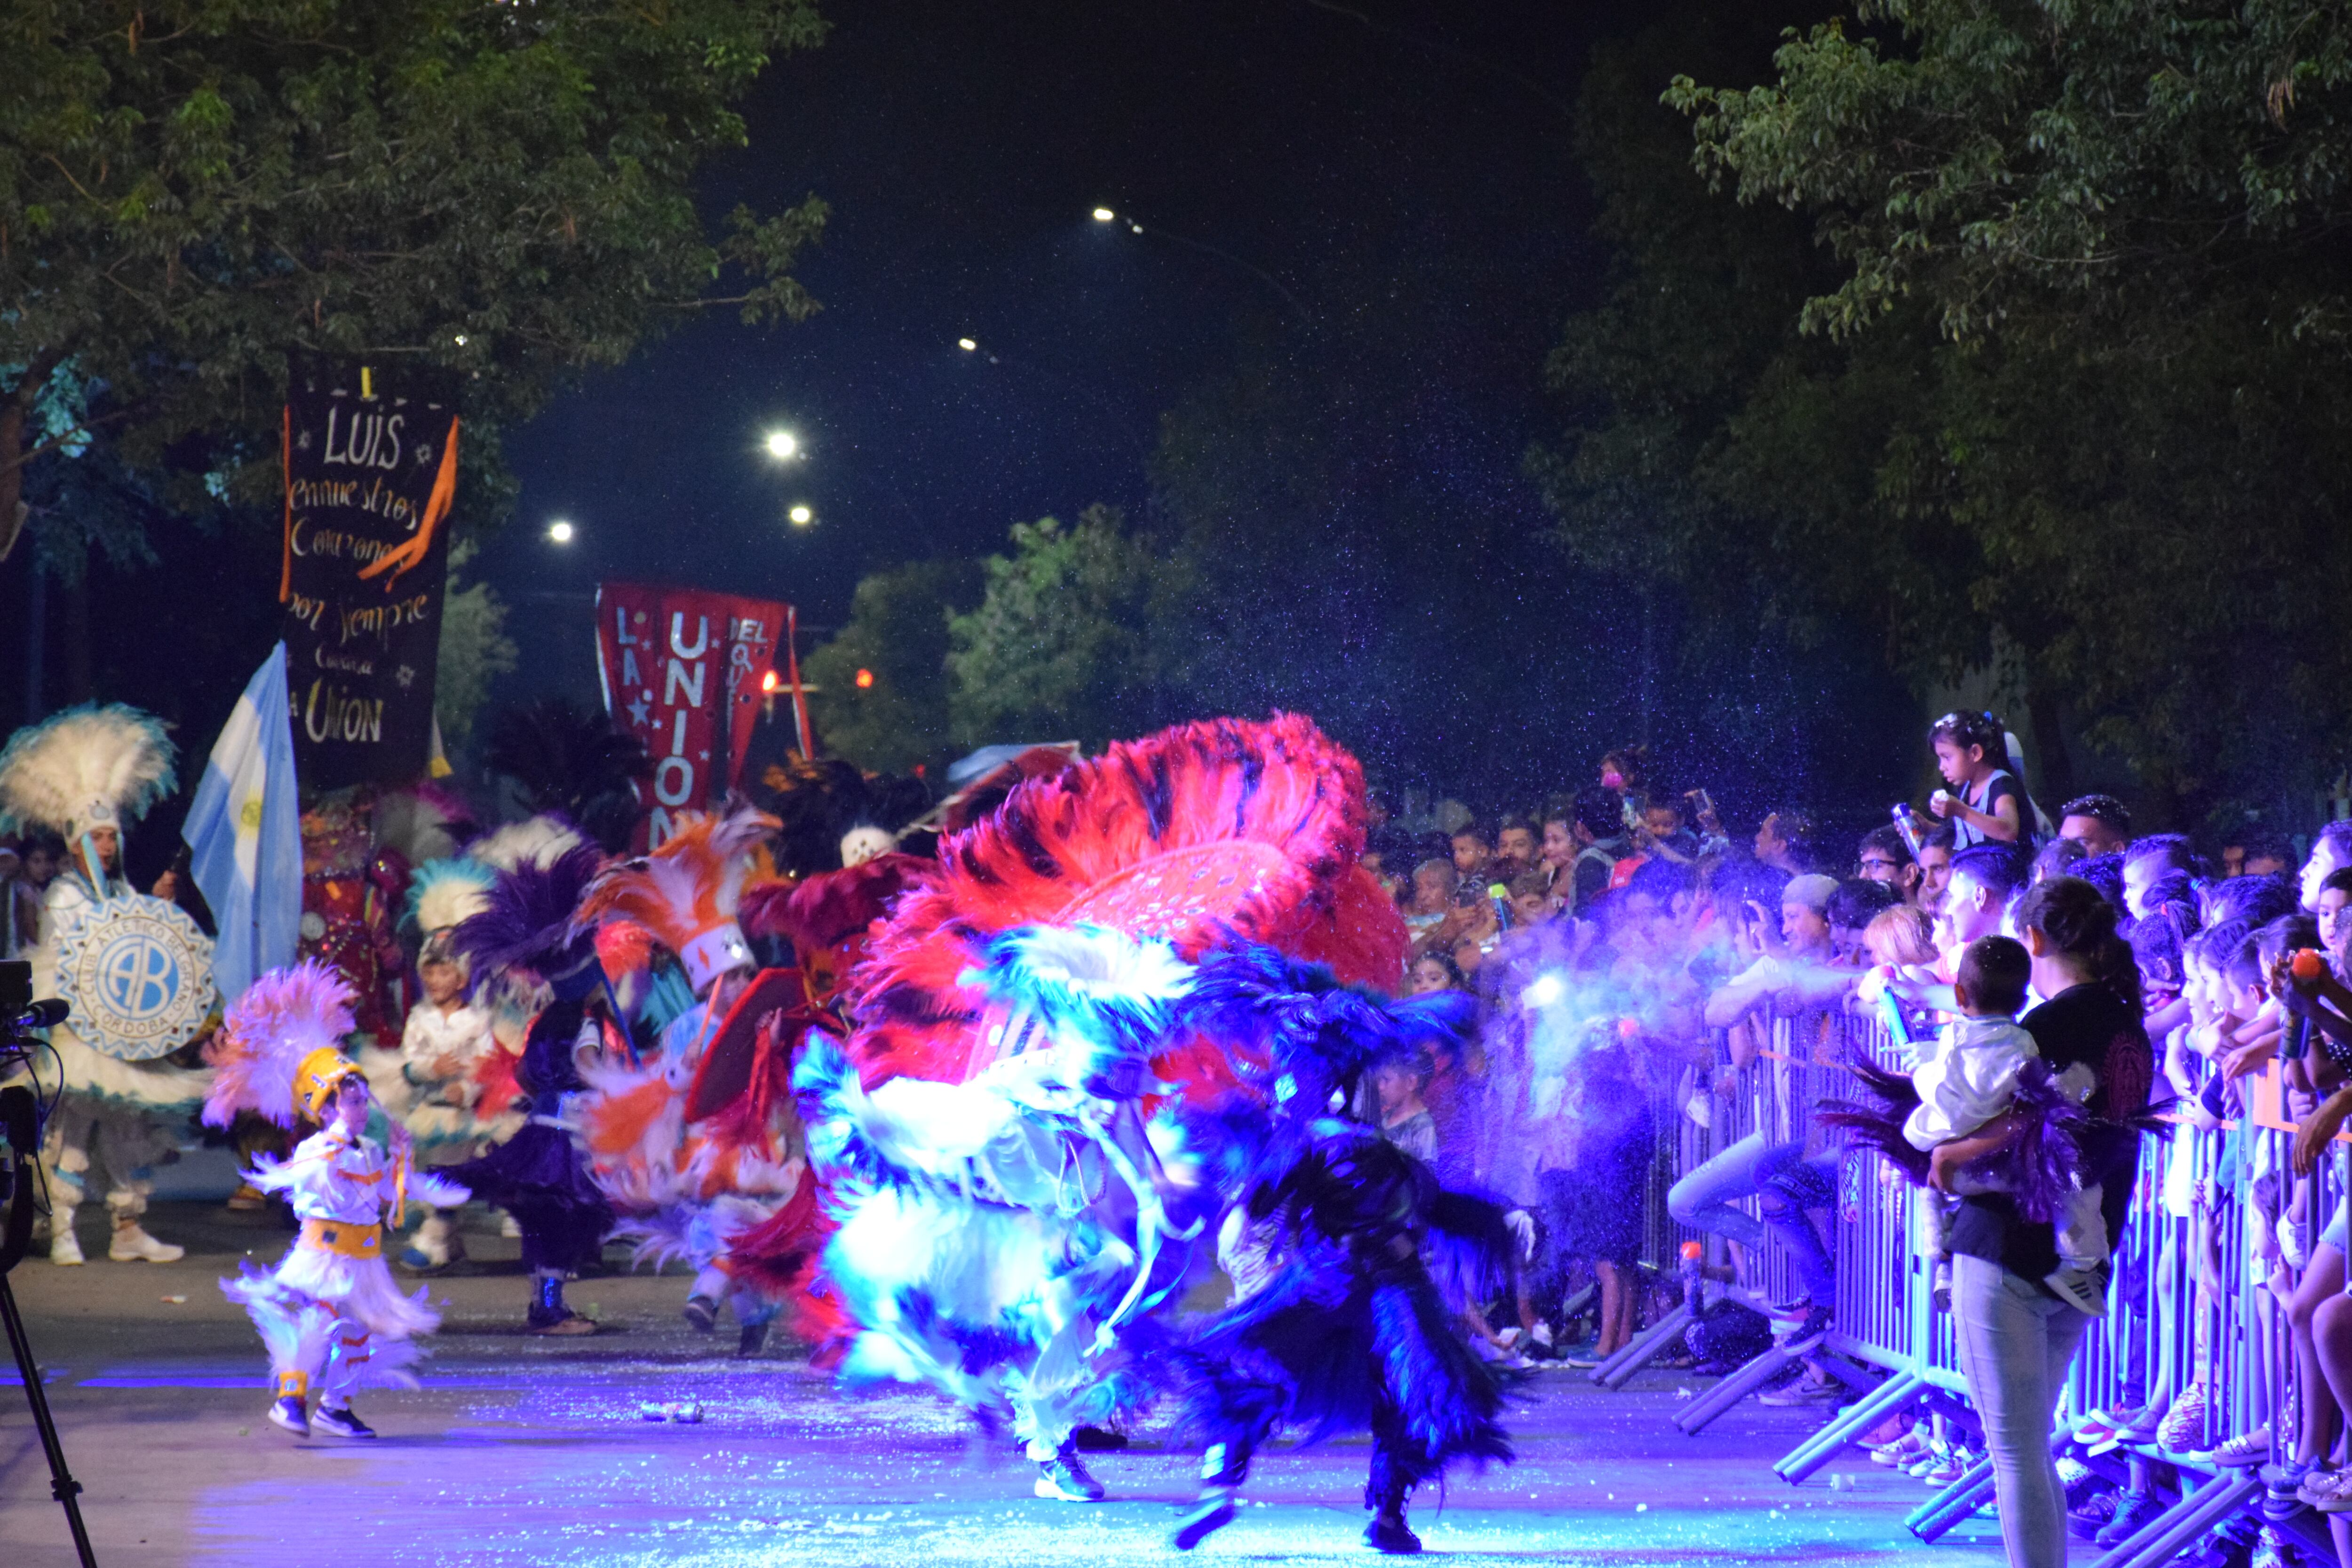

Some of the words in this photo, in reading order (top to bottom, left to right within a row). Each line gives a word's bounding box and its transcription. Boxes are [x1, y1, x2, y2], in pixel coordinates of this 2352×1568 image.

[82, 953, 97, 995] CLUB
[167, 936, 191, 1011] BELGRANO
[93, 1004, 167, 1034] CORDOBA
